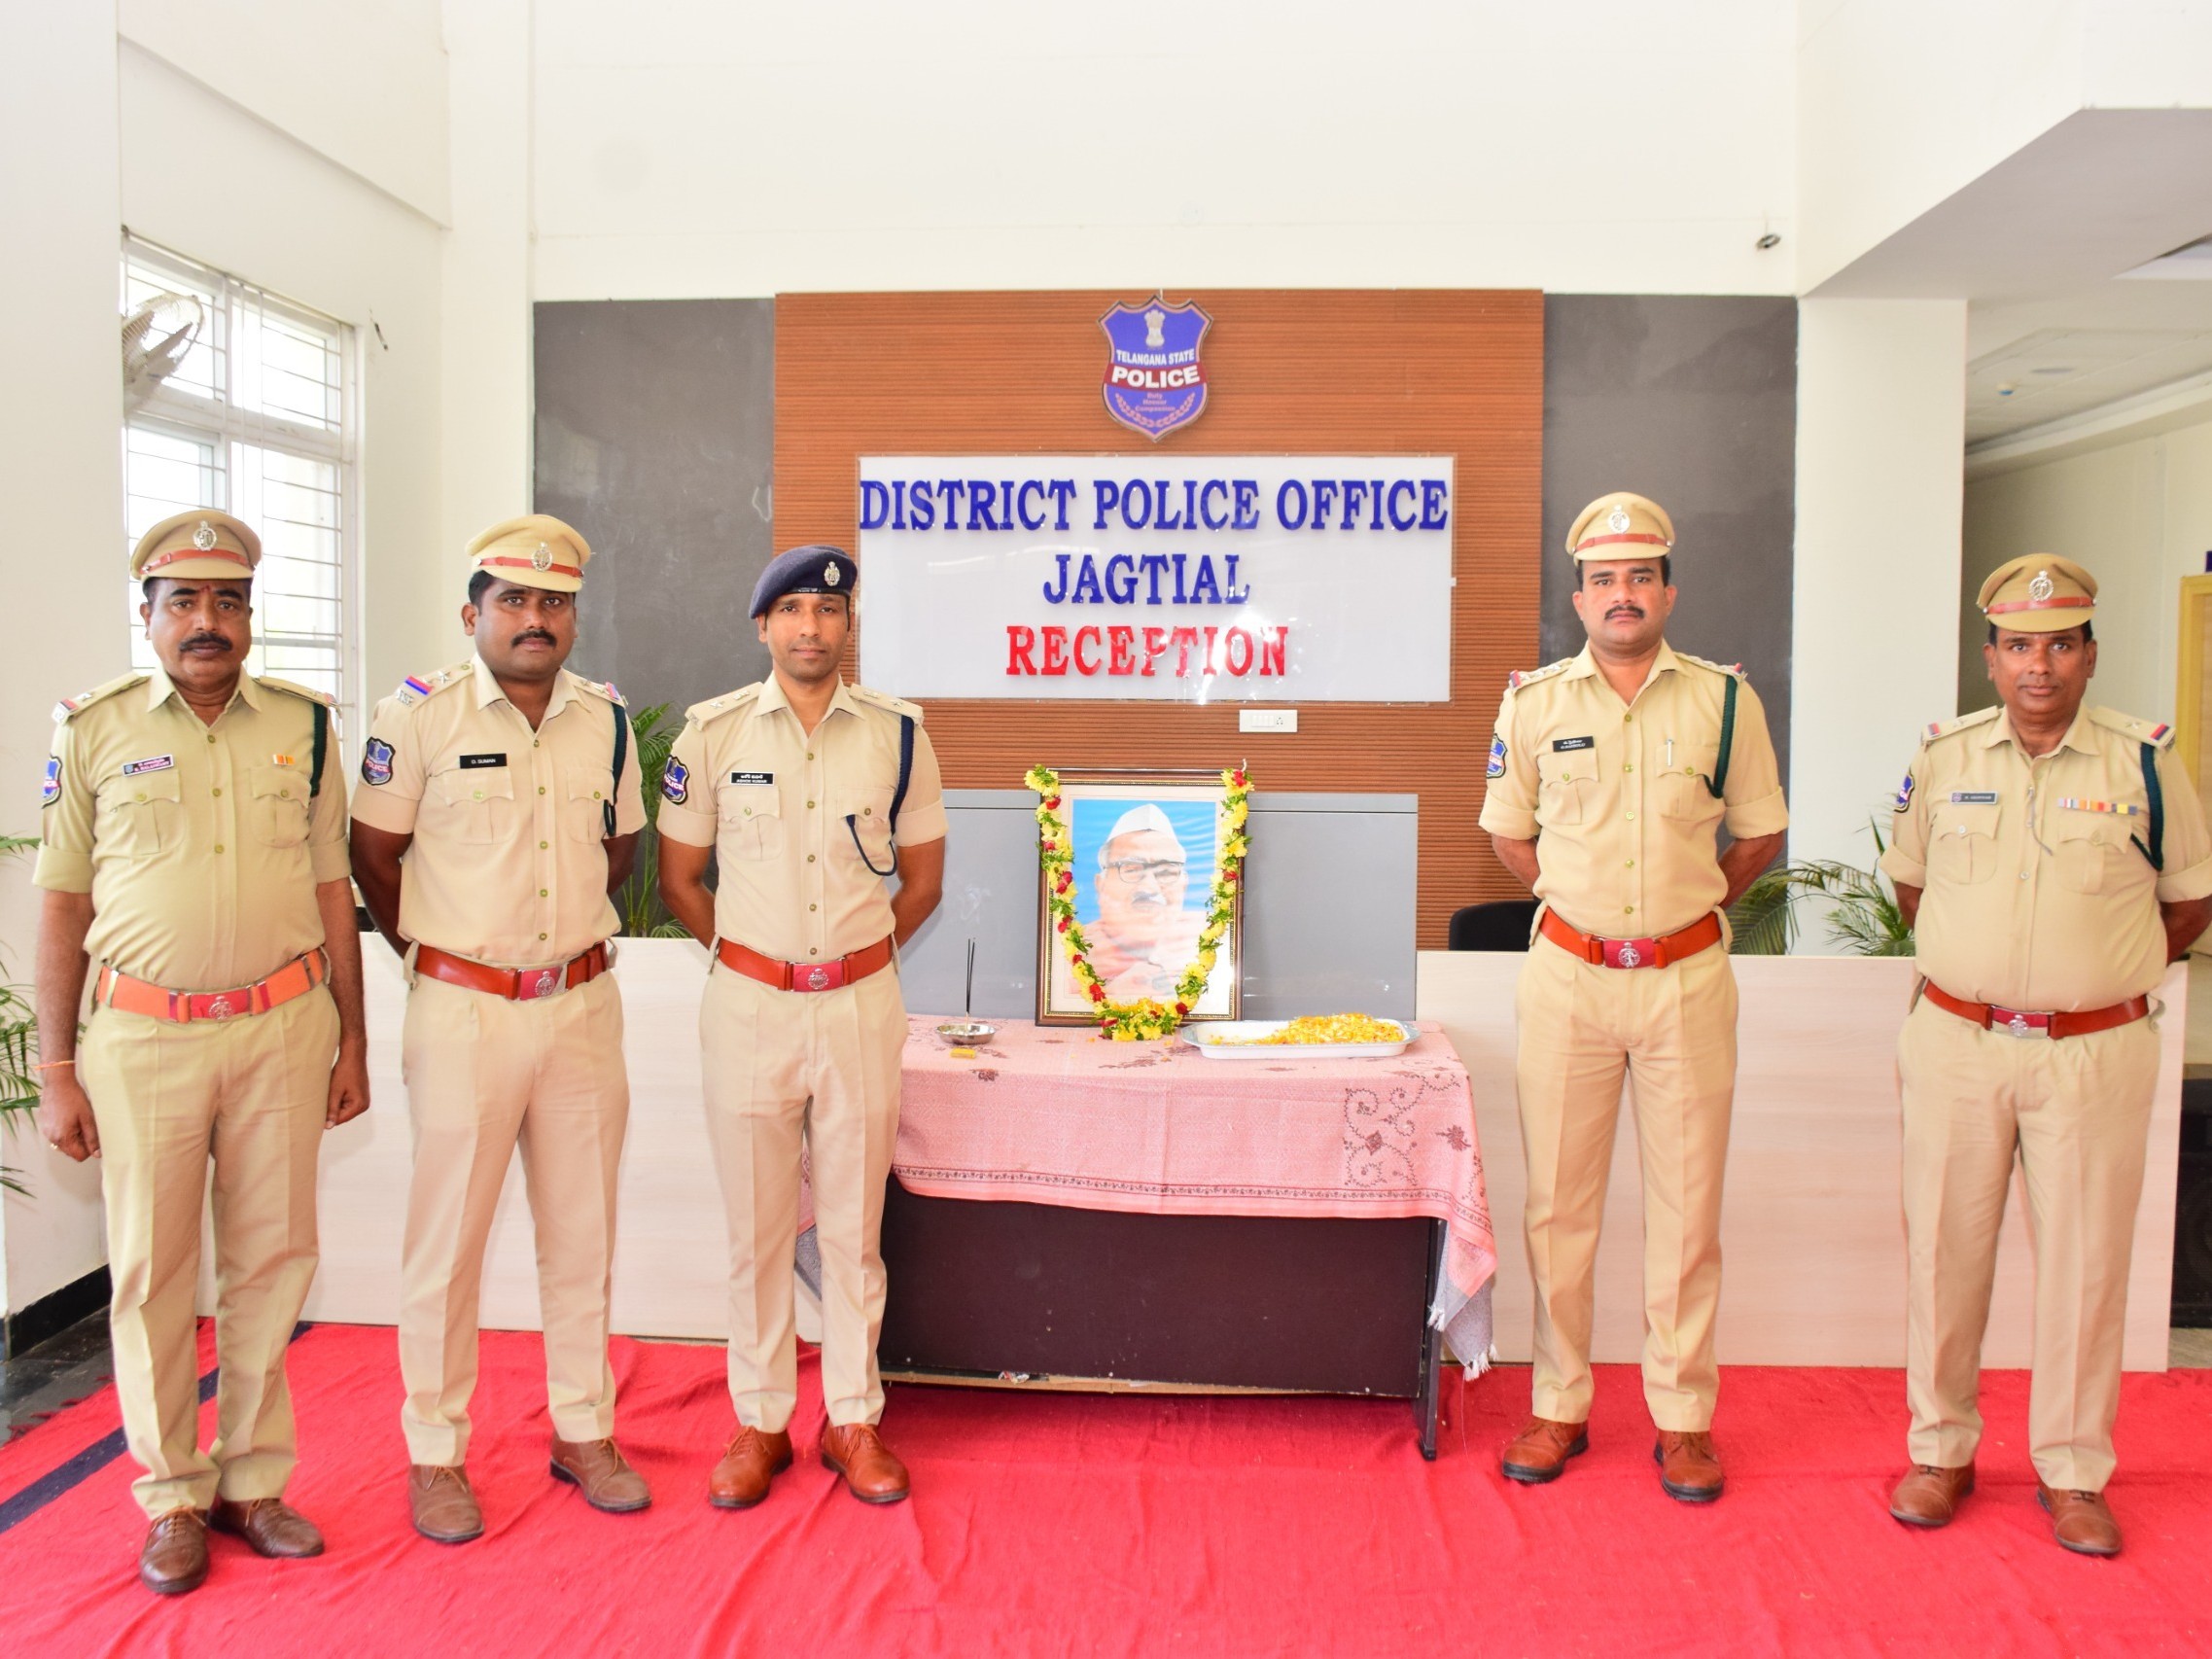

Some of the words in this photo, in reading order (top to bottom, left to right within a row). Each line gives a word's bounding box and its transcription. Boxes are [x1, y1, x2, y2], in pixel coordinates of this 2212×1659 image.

[1111, 365, 1201, 389] POLICE
[1115, 349, 1167, 366] TELANGANA
[1168, 348, 1195, 366] STATE
[860, 479, 1076, 531] DISTRICT
[1093, 478, 1259, 531] POLICE
[1276, 478, 1448, 531] OFFICE
[1043, 553, 1249, 605] JAGTIAL
[1006, 625, 1288, 677] RECEPTION
